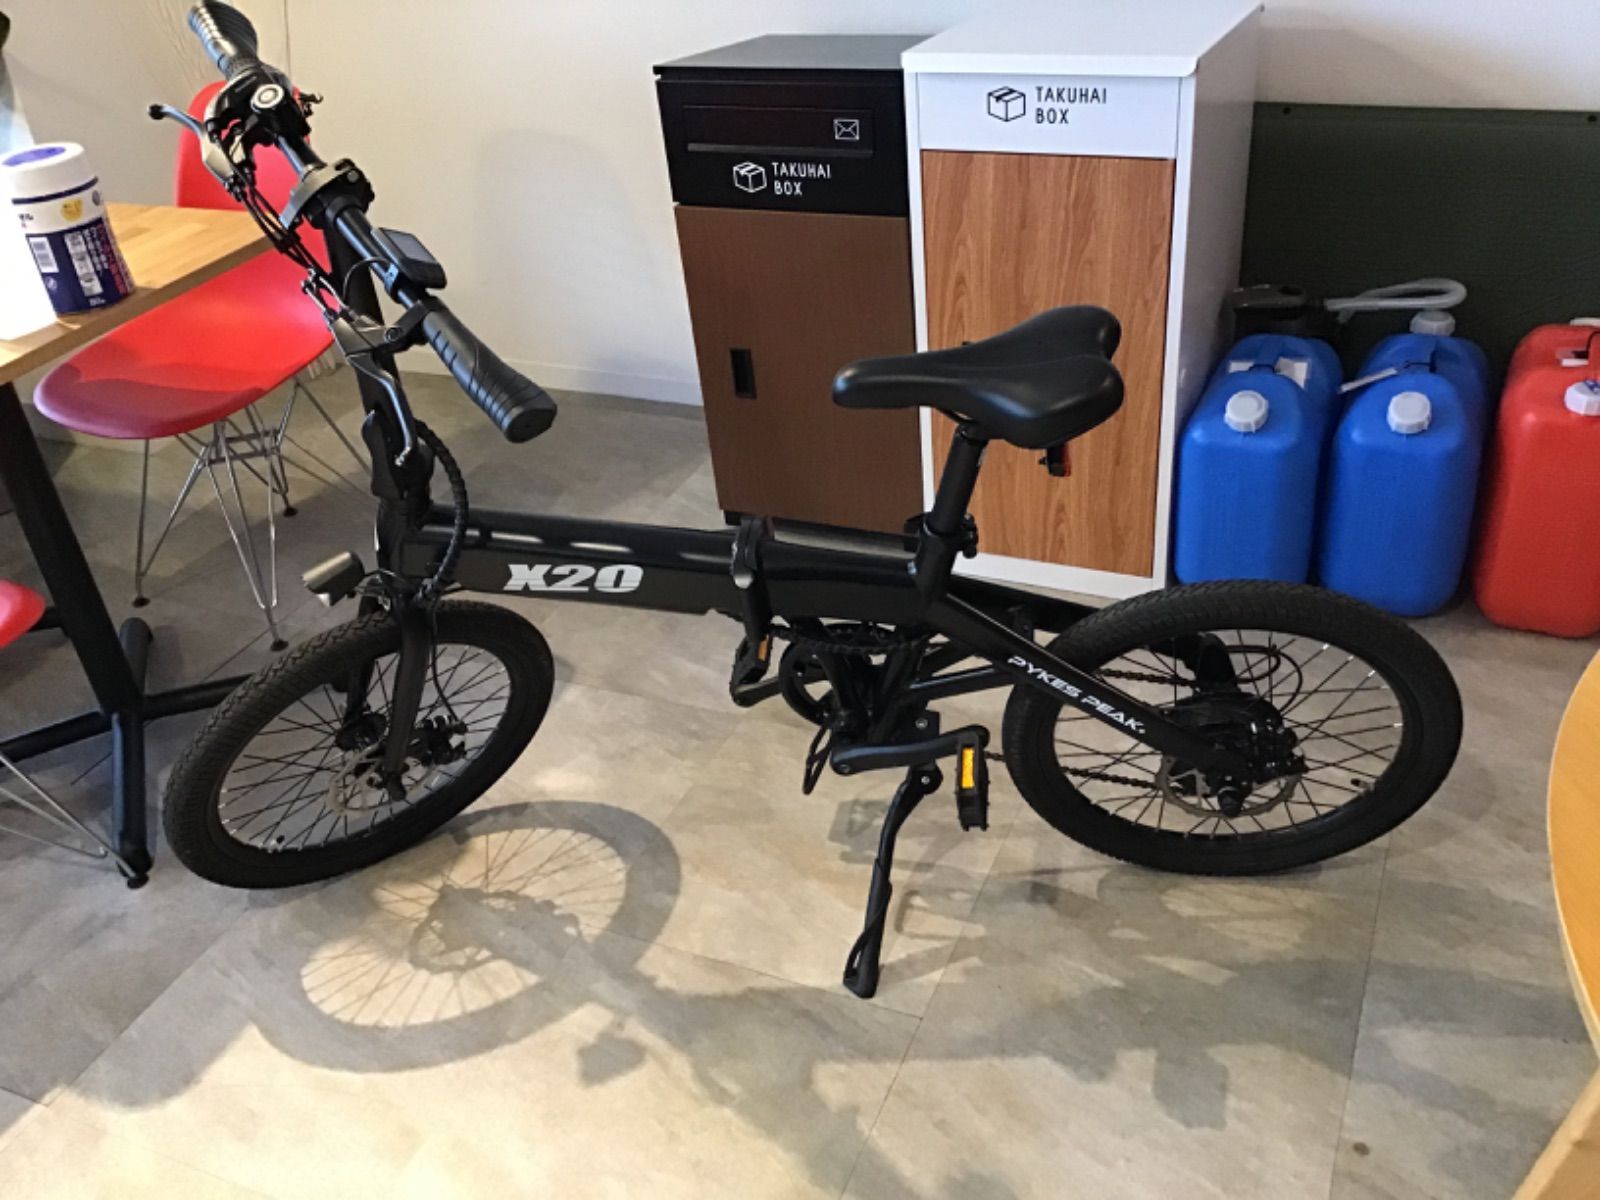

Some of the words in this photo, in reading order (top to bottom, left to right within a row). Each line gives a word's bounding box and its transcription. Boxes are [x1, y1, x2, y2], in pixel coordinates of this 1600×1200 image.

[1035, 86, 1107, 104] TAKUHAI
[1035, 107, 1069, 124] BOX
[771, 162, 831, 179] TAKUHAI
[774, 180, 803, 196] BOX
[502, 564, 644, 593] X20
[1007, 655, 1083, 698] PYKES
